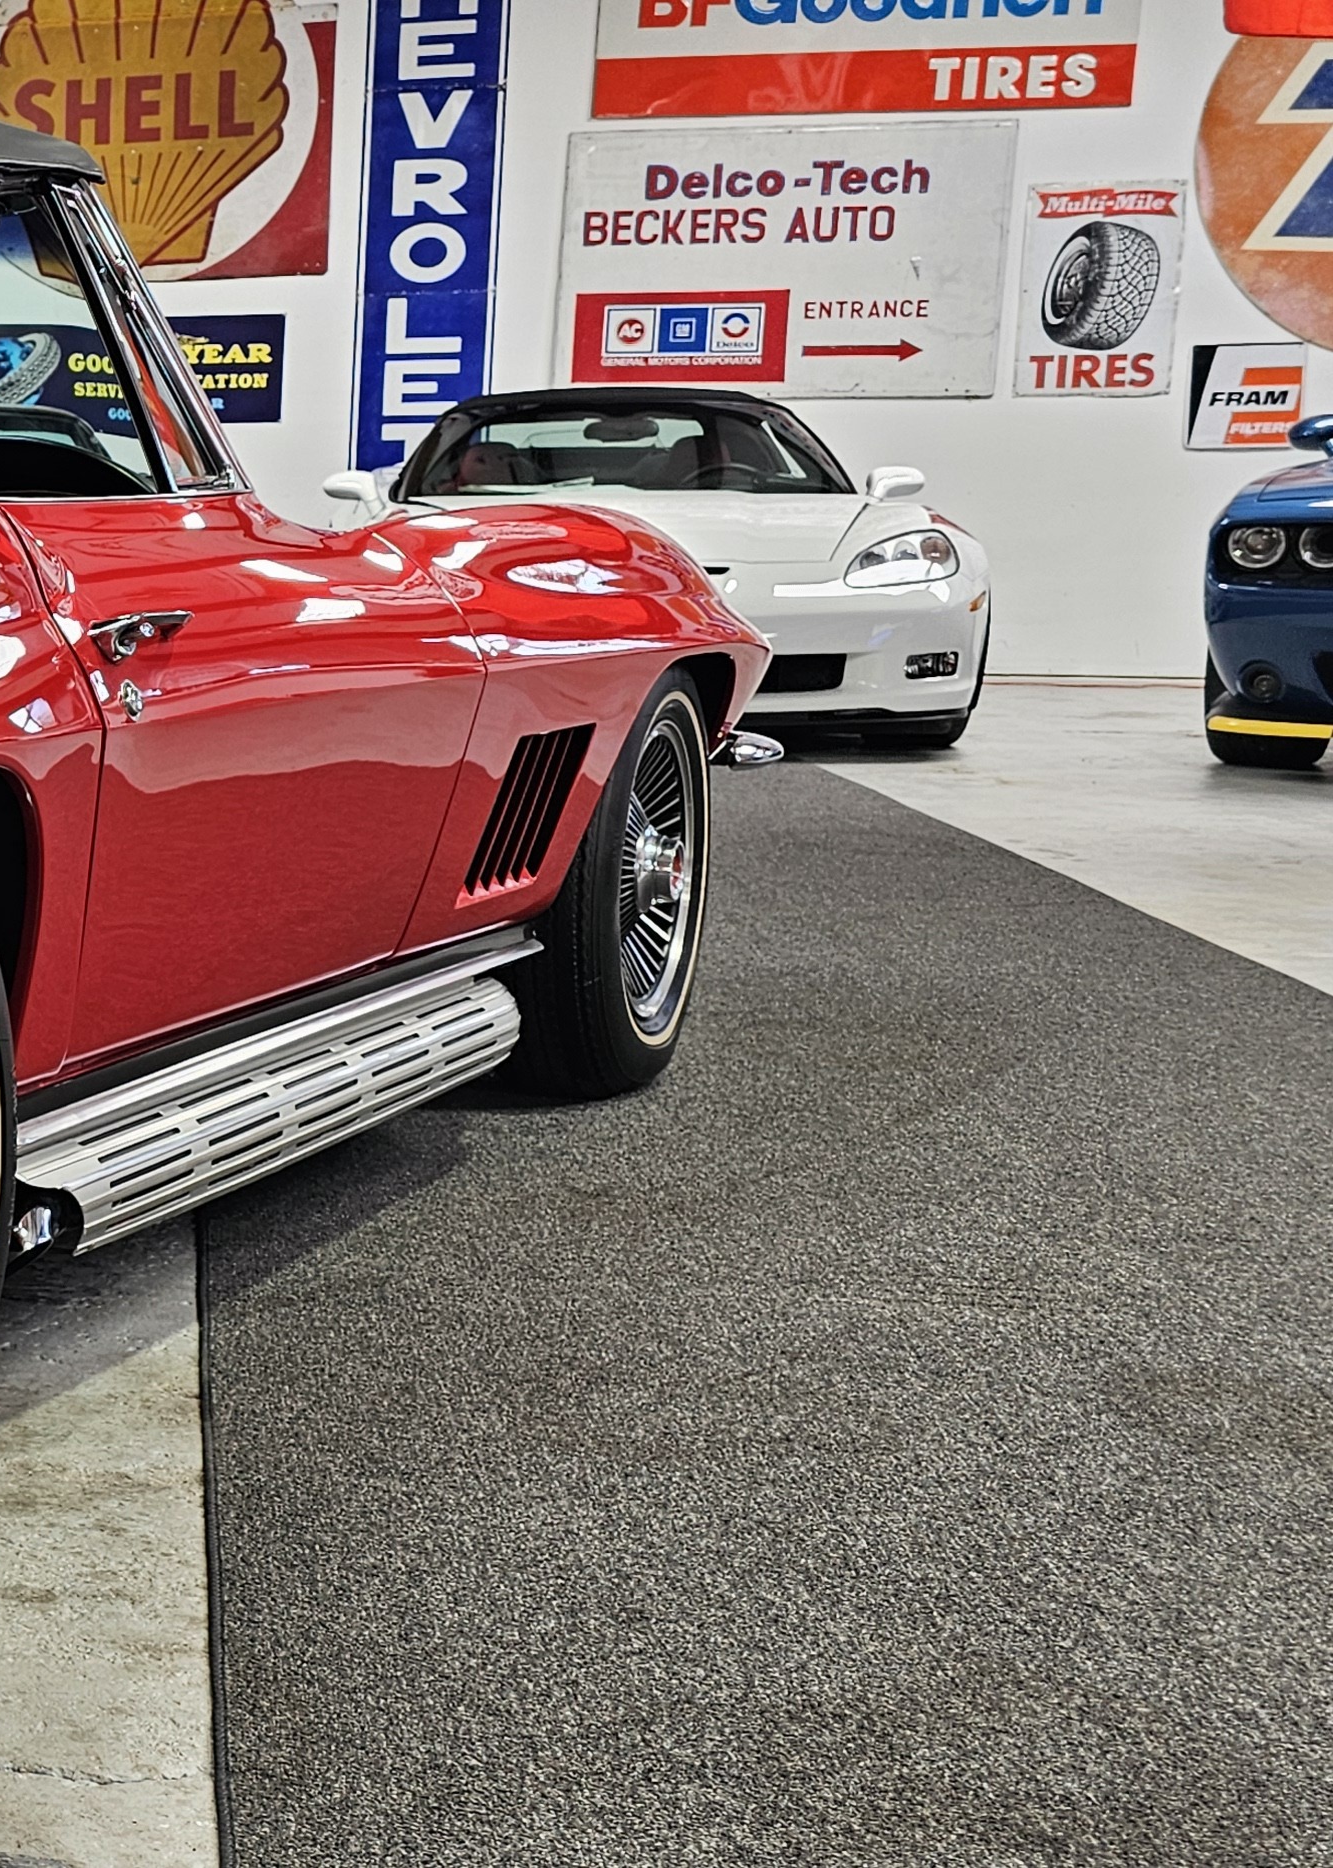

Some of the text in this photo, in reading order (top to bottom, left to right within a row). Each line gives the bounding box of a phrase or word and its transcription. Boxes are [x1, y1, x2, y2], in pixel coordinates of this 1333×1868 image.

[929, 52, 1098, 101] TIRES
[14, 69, 254, 146] SHELL
[1043, 192, 1167, 214] Multi-Mile
[583, 206, 896, 246] BECKERS AUTO
[804, 299, 930, 319] ENTRANCE
[618, 322, 643, 339] AC
[692, 355, 762, 365] CORPORATION
[1029, 353, 1155, 389] TIRES
[1209, 391, 1288, 406] FRAM
